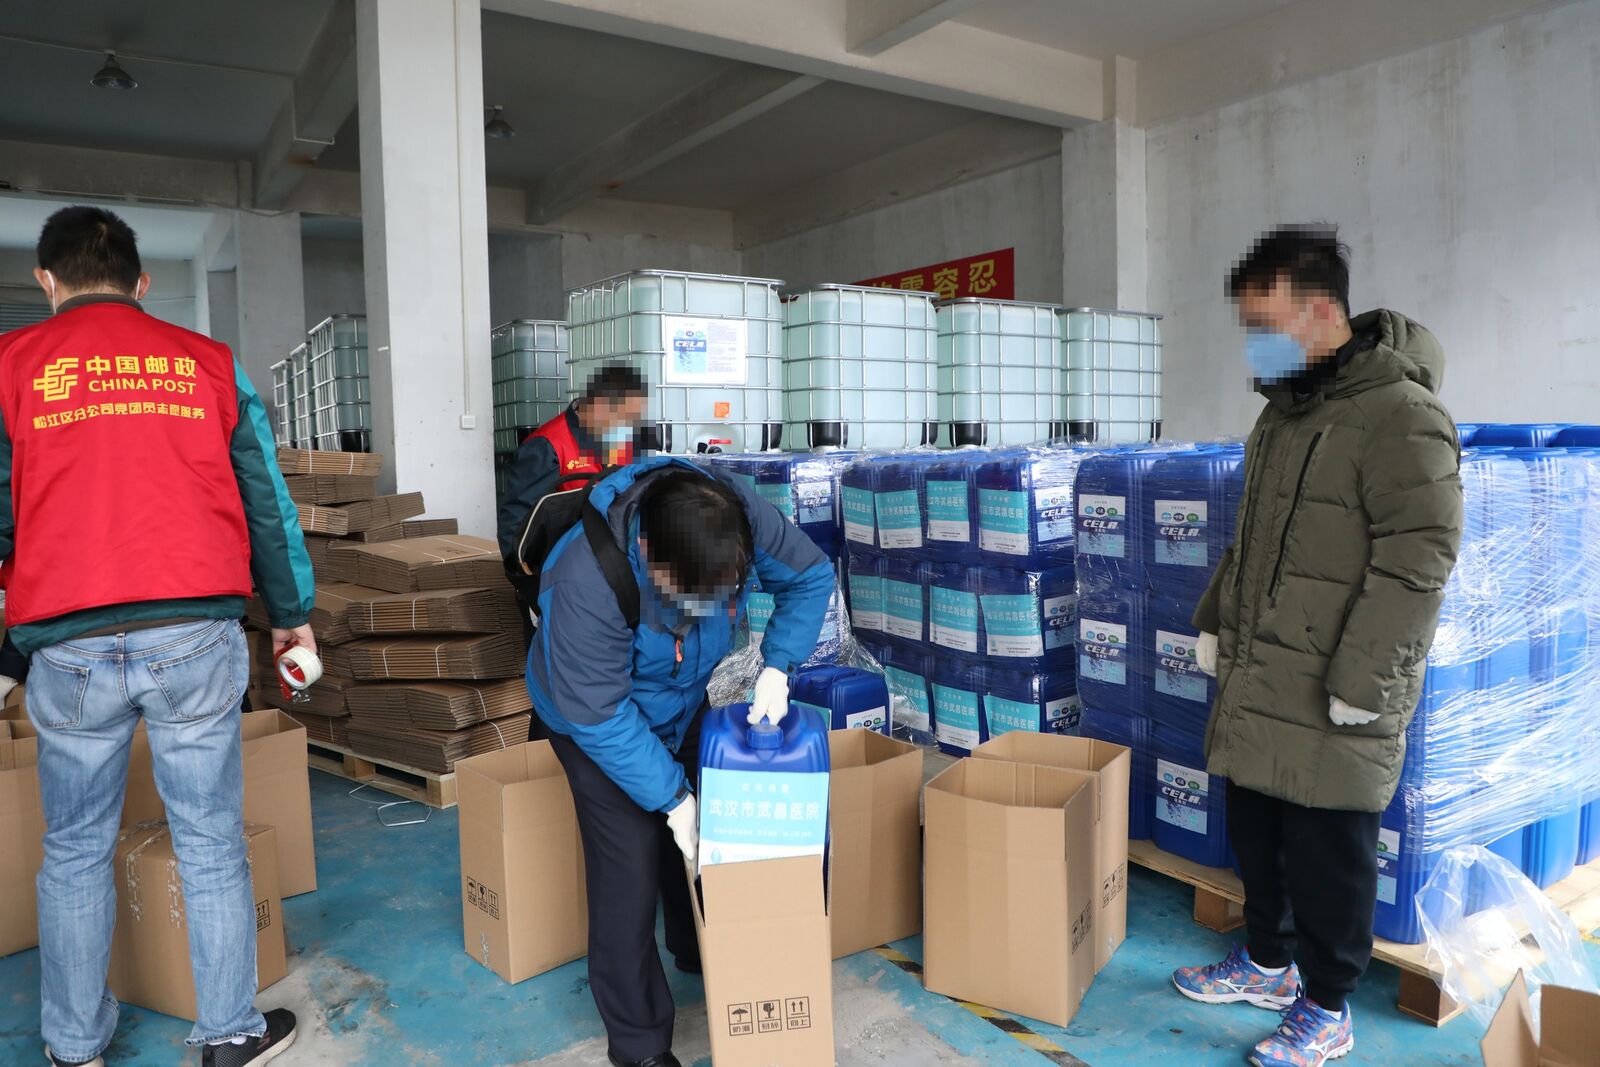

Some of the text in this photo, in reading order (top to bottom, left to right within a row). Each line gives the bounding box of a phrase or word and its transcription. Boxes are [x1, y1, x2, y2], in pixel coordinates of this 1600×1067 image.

[872, 259, 997, 300] 零容忍
[85, 355, 196, 378] 中国邮政
[88, 378, 196, 395] CHINA POST
[32, 401, 205, 430] 松江区分公司党团员志愿服务
[1082, 519, 1119, 530] CELA
[1160, 526, 1200, 537] CELA
[1085, 644, 1120, 657] CELA
[1160, 657, 1199, 671] CELA
[1161, 786, 1201, 805] CELA
[708, 798, 820, 821] 武汉市武昌医院
